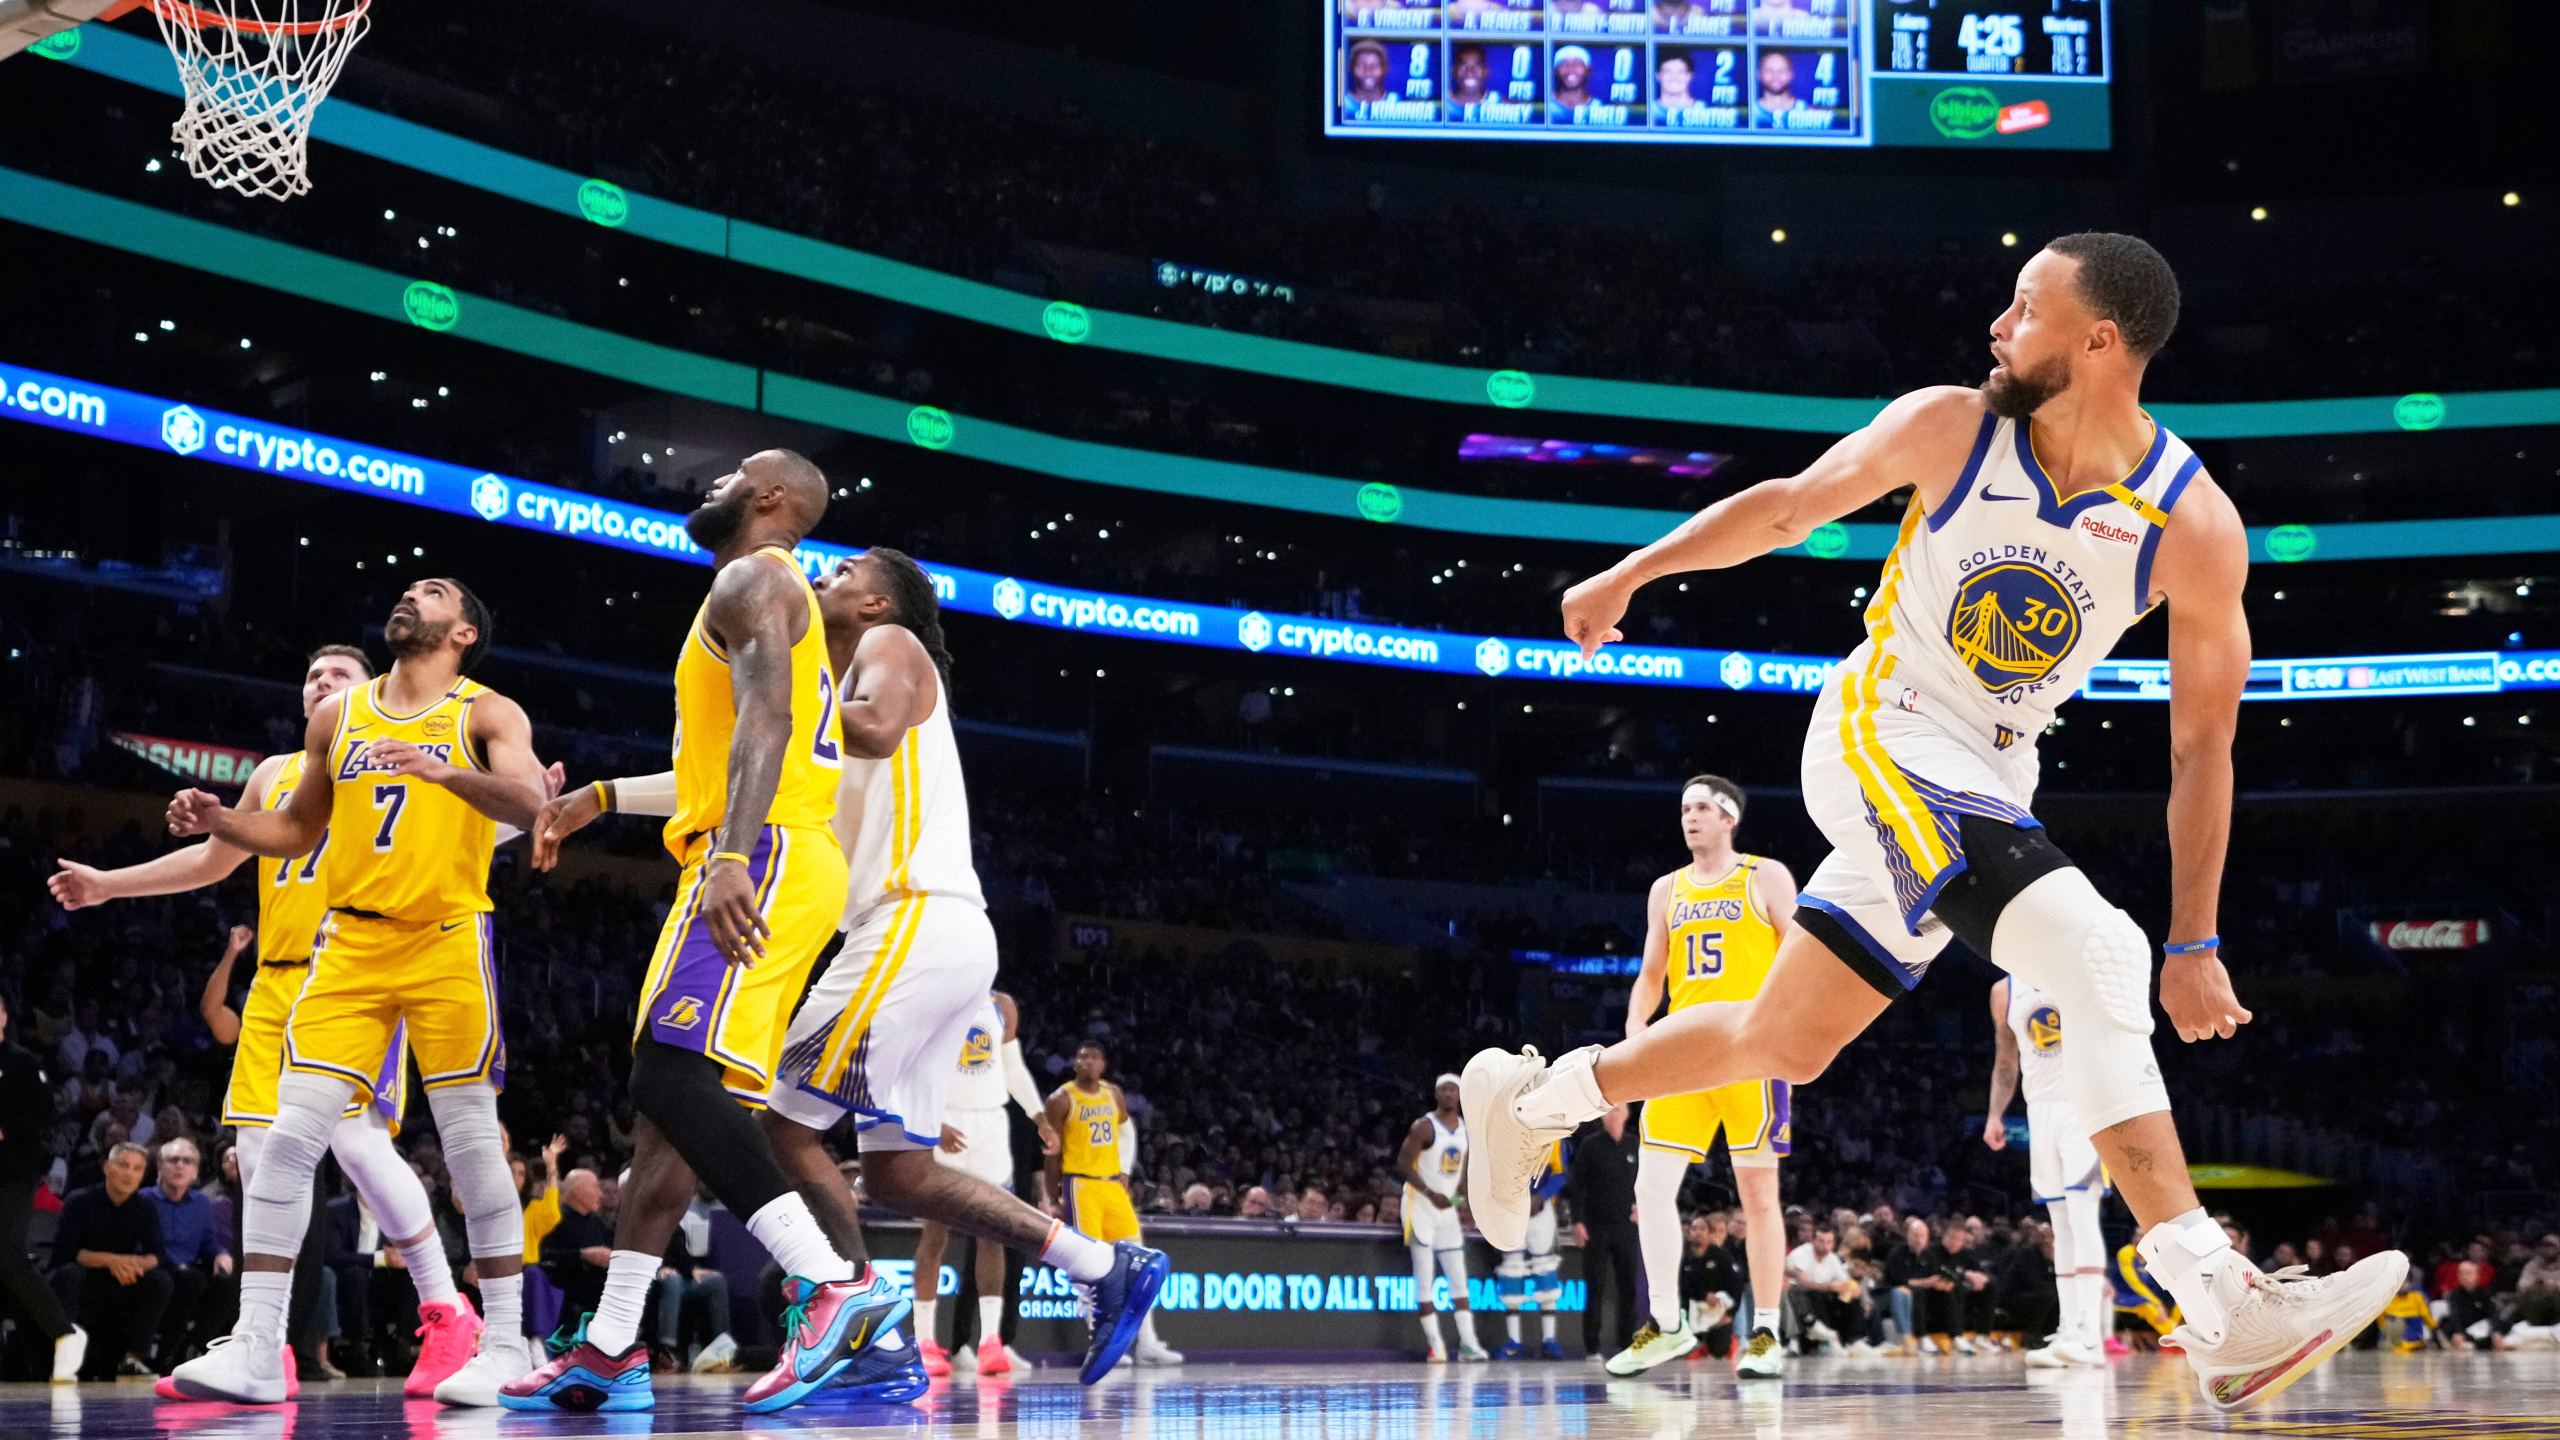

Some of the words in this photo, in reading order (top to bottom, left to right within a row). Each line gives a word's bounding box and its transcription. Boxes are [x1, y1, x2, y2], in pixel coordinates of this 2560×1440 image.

[1958, 14, 2023, 56] 4:25
[1409, 44, 1428, 77] 8
[1511, 46, 1531, 79] 0
[1613, 48, 1632, 81] 0
[1715, 51, 1734, 84] 2
[1815, 53, 1834, 86] 4
[1406, 78, 1432, 98] PTS
[1508, 80, 1533, 99] PTS
[1610, 83, 1636, 102] PTS
[0, 377, 106, 427] .com
[215, 424, 425, 495] crypto.com
[2081, 516, 2139, 546] Rakuten
[1959, 545, 2047, 572] GOLDEN
[2054, 560, 2096, 614] STATE
[1030, 590, 1200, 636] crypto.com
[2015, 596, 2068, 637] 30
[1277, 623, 1439, 663] crypto.com
[2404, 667, 2447, 684] WEST
[2447, 665, 2492, 683] BANK
[337, 740, 451, 781] LAS
[374, 784, 407, 849] 7
[1671, 899, 1743, 930] LAKERS
[1686, 932, 1722, 976] 15
[1079, 1105, 1114, 1121] LAKERS
[1089, 1121, 1112, 1143] 28
[1019, 1266, 1080, 1297] PAS
[1153, 1272, 1199, 1311] UR
[1203, 1271, 1284, 1311] DOOR
[1285, 1272, 1323, 1311] TO
[1325, 1274, 1375, 1311] ALL
[1374, 1275, 1455, 1312] THIG
